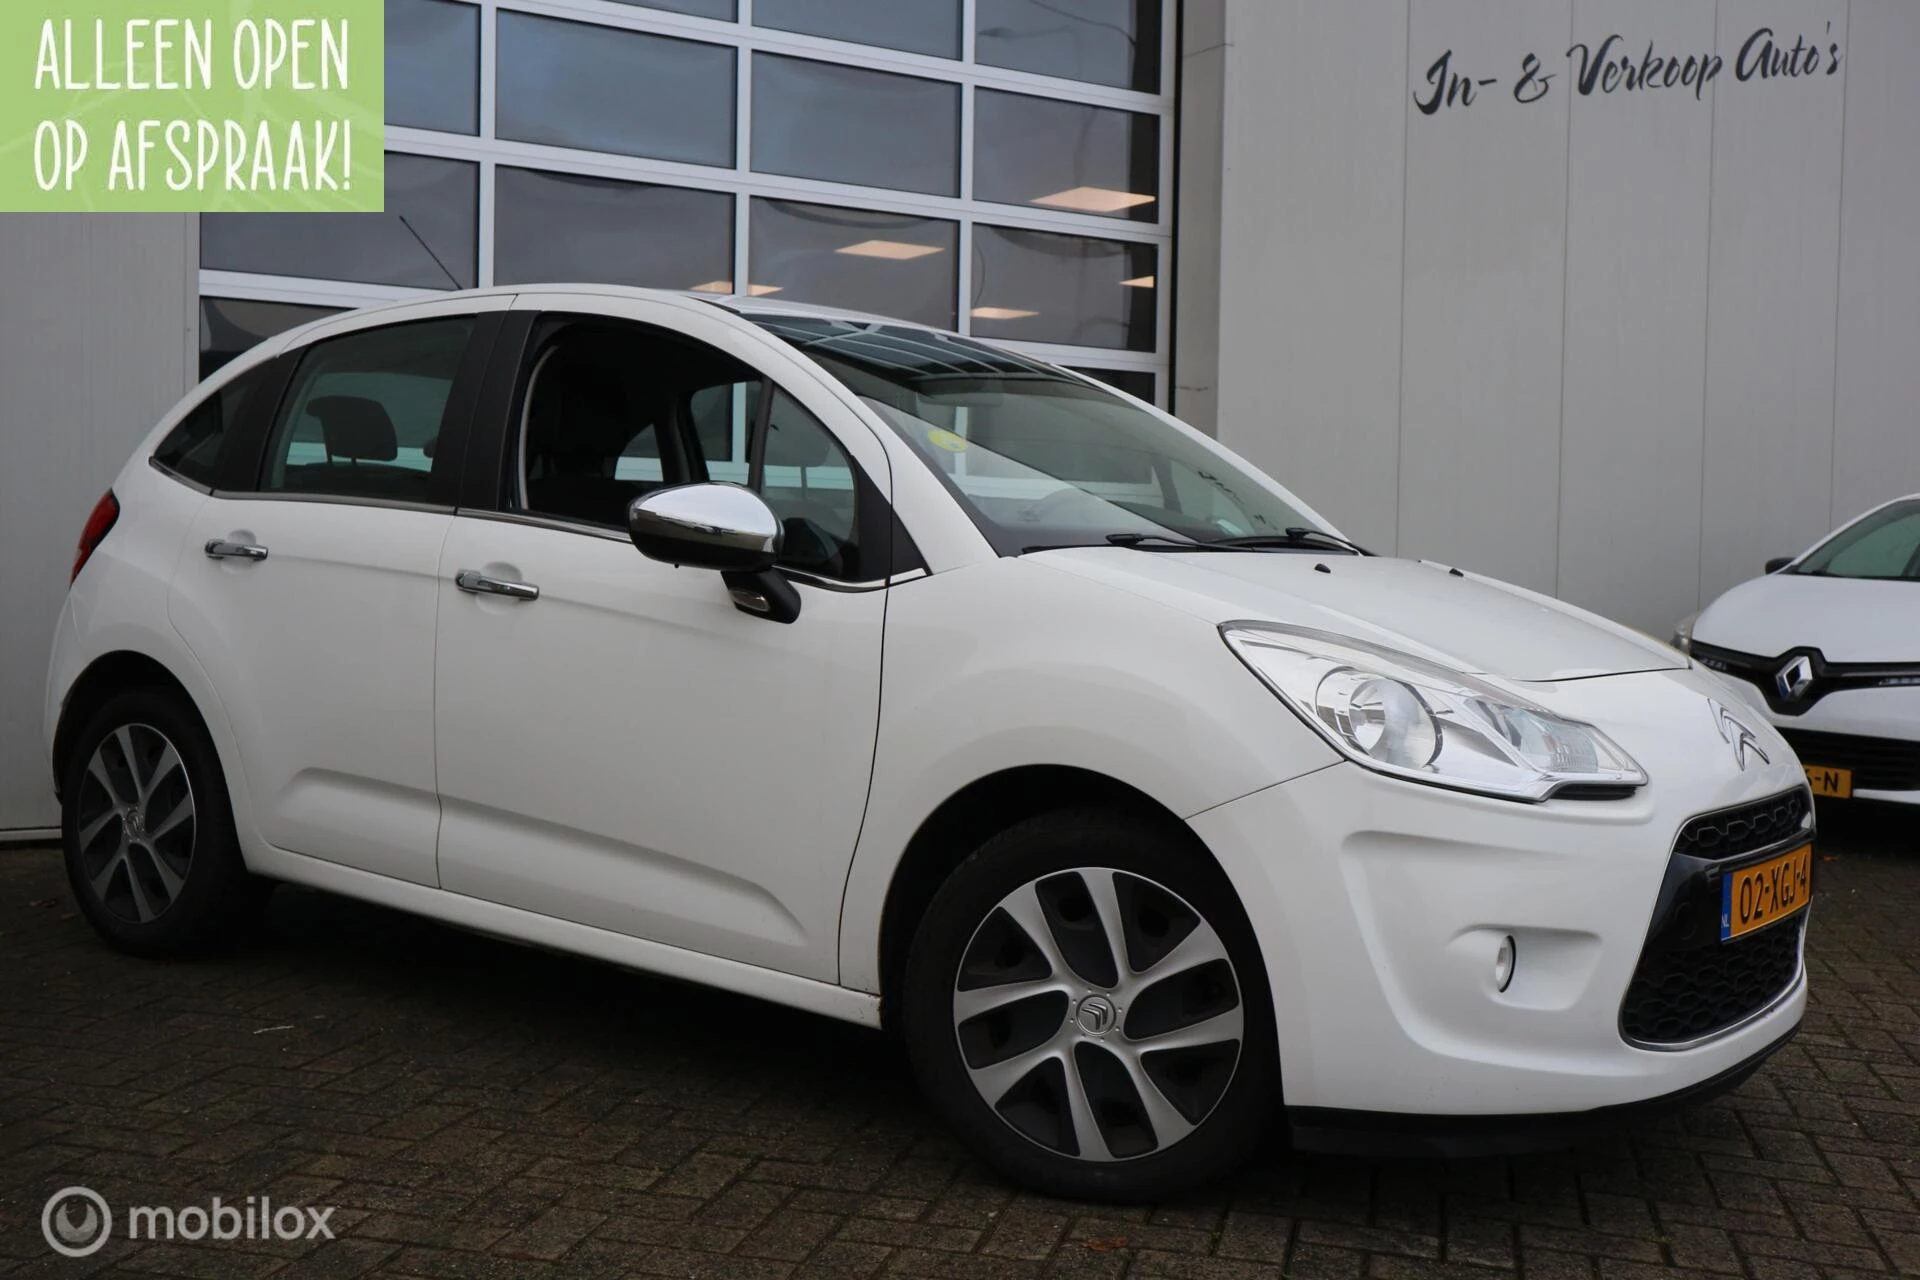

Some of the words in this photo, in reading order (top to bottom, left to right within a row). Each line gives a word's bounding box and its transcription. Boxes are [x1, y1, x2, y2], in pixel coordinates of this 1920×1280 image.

[1413, 50, 1498, 115] In-
[1513, 53, 1556, 103] &
[1566, 34, 1723, 99] Verkoop
[1735, 22, 1841, 82] Auto's
[1739, 853, 1808, 925] 02-XGJ-4
